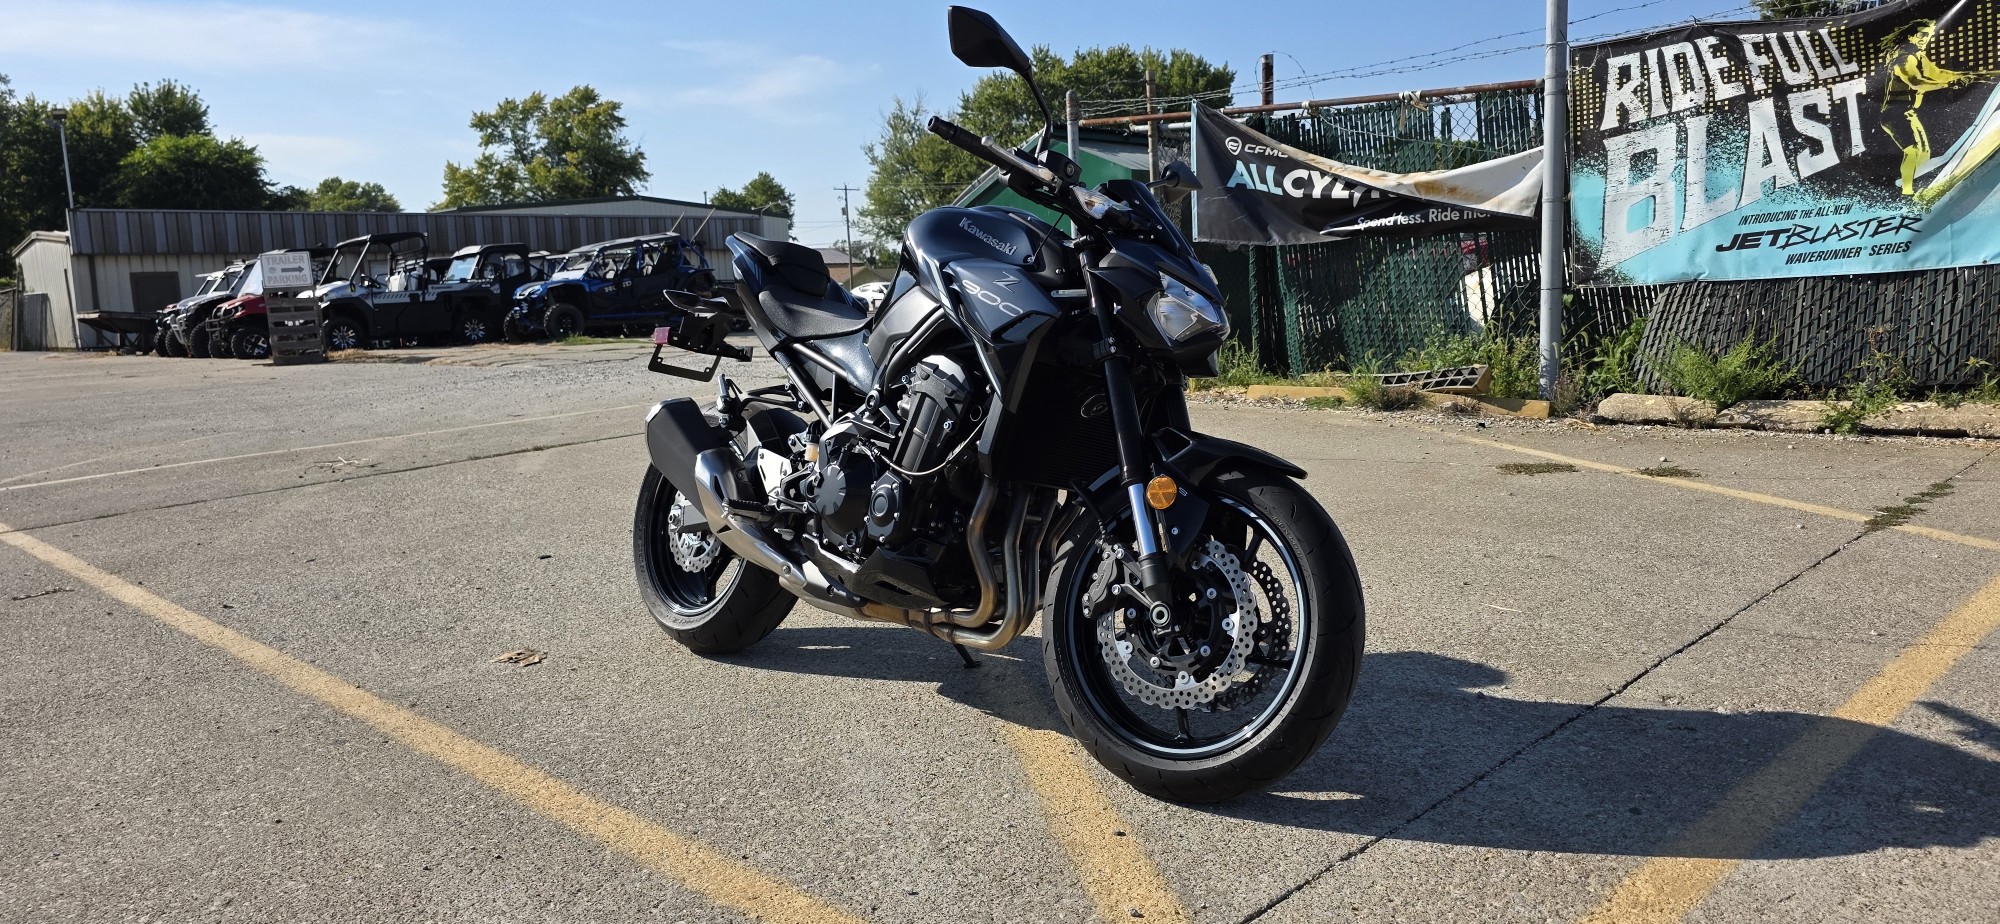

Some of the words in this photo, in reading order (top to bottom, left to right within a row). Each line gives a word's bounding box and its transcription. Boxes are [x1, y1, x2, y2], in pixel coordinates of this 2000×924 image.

[1600, 36, 1746, 131] RIDE
[1737, 28, 1859, 91] FULL
[1600, 78, 1867, 272] BLAST
[1428, 208, 1460, 222] Ride
[1738, 208, 1796, 227] INTRODUCING
[1799, 207, 1813, 219] THE
[1814, 203, 1853, 218] ALL-NEW
[958, 217, 1017, 256] Kawasaki
[1715, 216, 1924, 252] JETBLASTER
[1868, 241, 1912, 257] SERIES
[265, 255, 305, 265] TRAILER
[266, 274, 308, 284] PARKING
[962, 279, 1024, 317] 900
